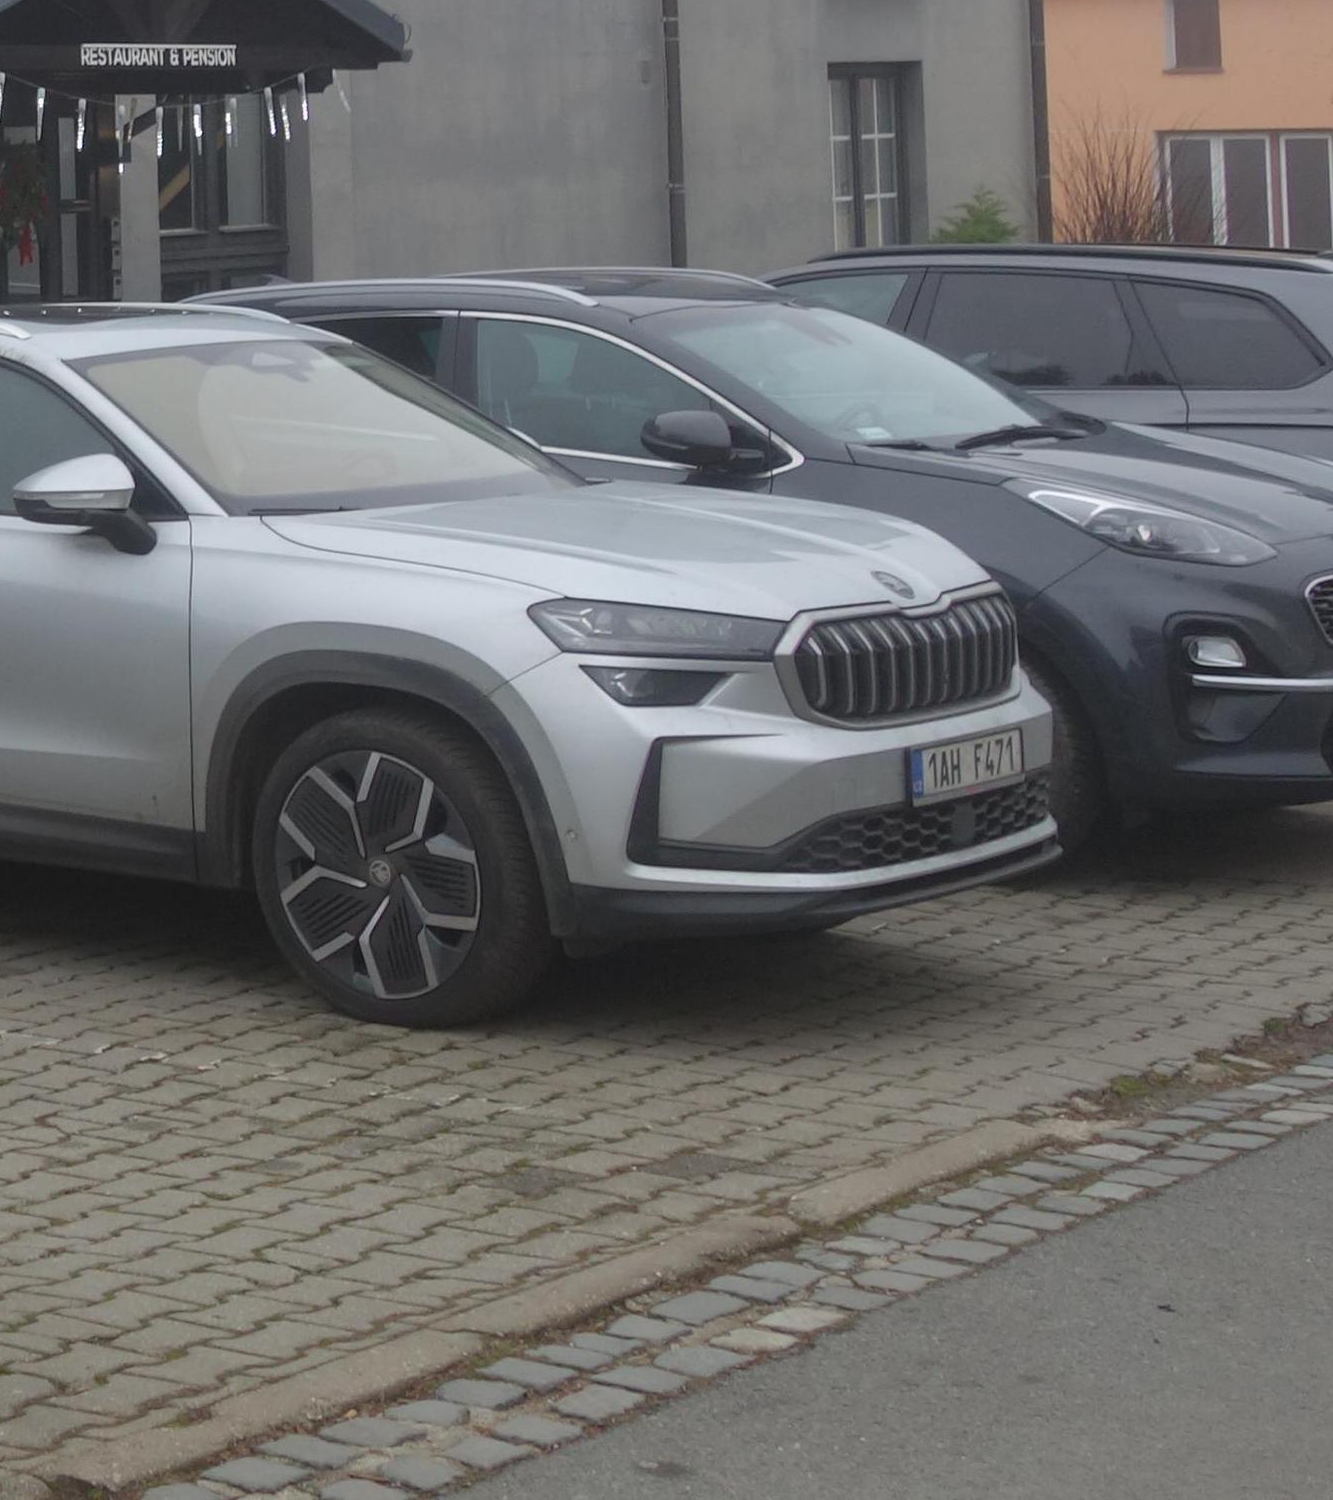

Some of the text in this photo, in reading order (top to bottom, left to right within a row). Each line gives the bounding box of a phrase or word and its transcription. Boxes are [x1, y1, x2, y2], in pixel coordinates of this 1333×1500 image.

[81, 47, 236, 67] RESTAURANT & PENSION
[928, 735, 1014, 789] 1AH F471
